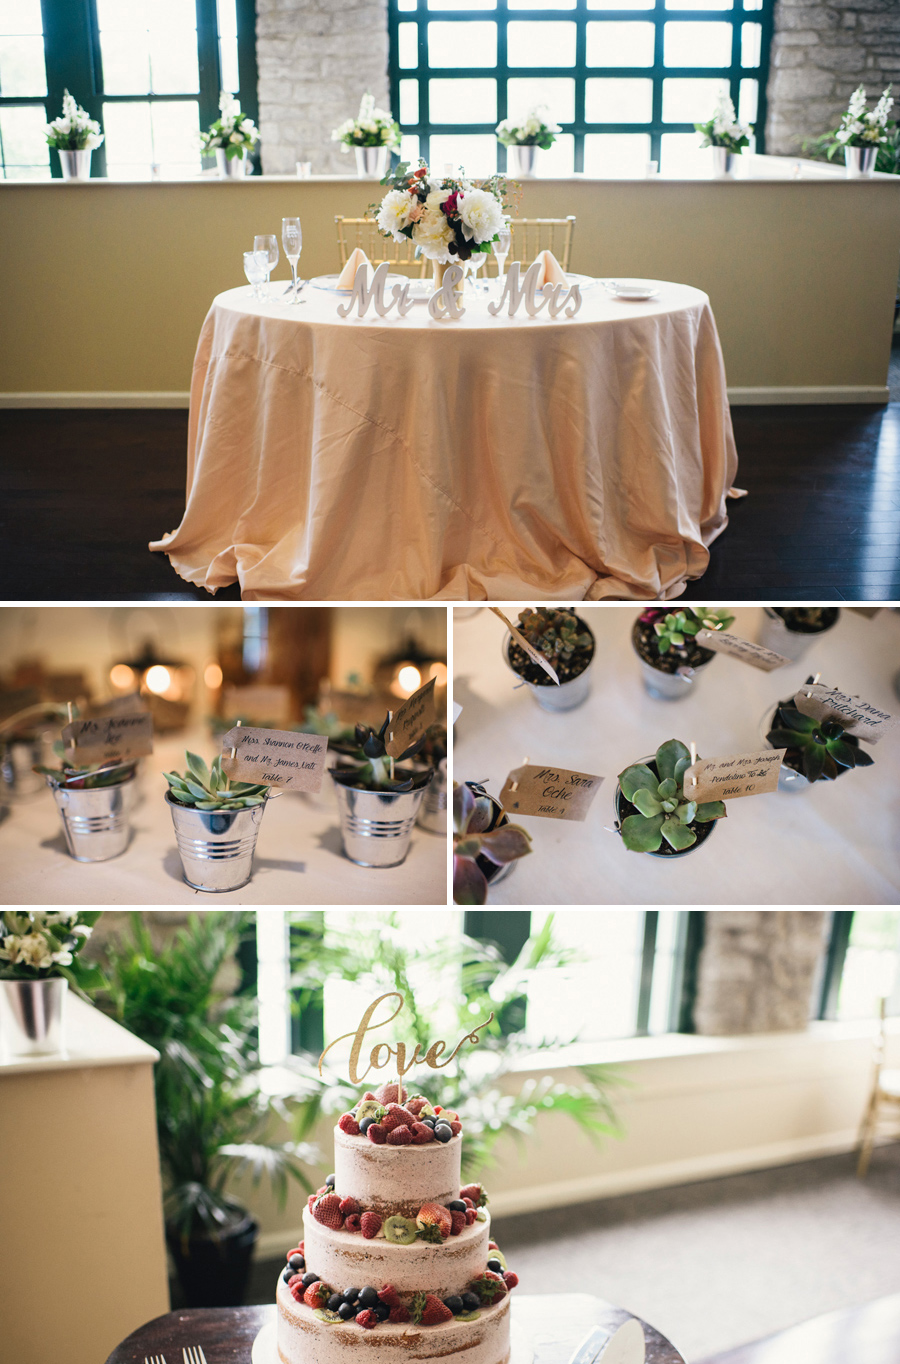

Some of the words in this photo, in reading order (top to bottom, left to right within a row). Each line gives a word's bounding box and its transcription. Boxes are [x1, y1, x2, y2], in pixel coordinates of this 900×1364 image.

[337, 262, 414, 317] Mr
[428, 265, 466, 319] &
[487, 262, 583, 317] Mrs
[855, 702, 891, 720] Dana
[262, 737, 295, 749] Shannon
[244, 754, 260, 763] and
[273, 758, 299, 768] James
[719, 759, 736, 769] and
[754, 754, 781, 766] Joseph
[261, 773, 284, 783] Table
[285, 776, 294, 784] 7
[533, 769, 560, 784] Mrs.
[565, 774, 594, 789] Sara
[722, 786, 741, 796] Table
[745, 784, 756, 792] 10
[537, 805, 558, 814] Table
[318, 992, 494, 1084] love
